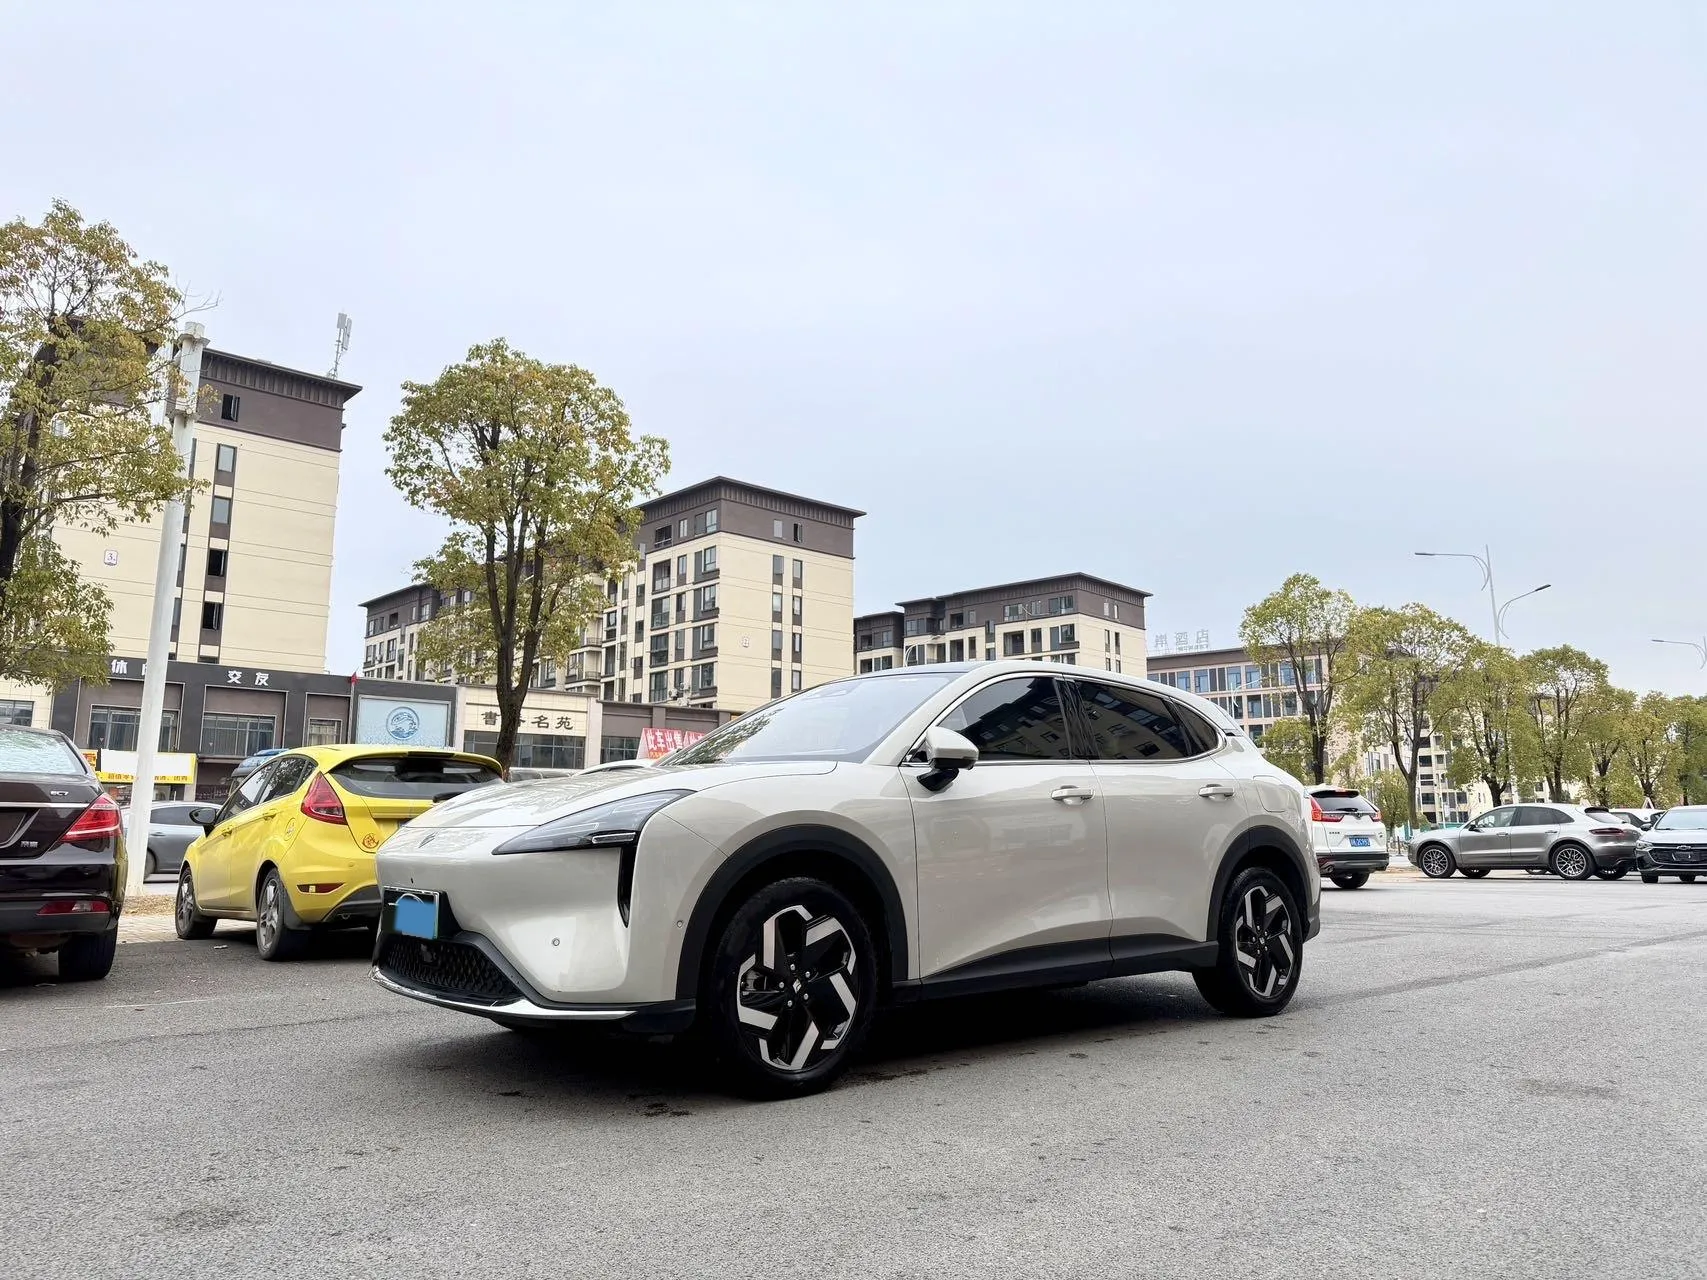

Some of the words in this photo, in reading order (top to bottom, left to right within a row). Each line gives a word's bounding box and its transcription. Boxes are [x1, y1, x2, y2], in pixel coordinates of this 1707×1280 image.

[226, 670, 270, 686] 交友
[480, 711, 573, 731] 書名苑
